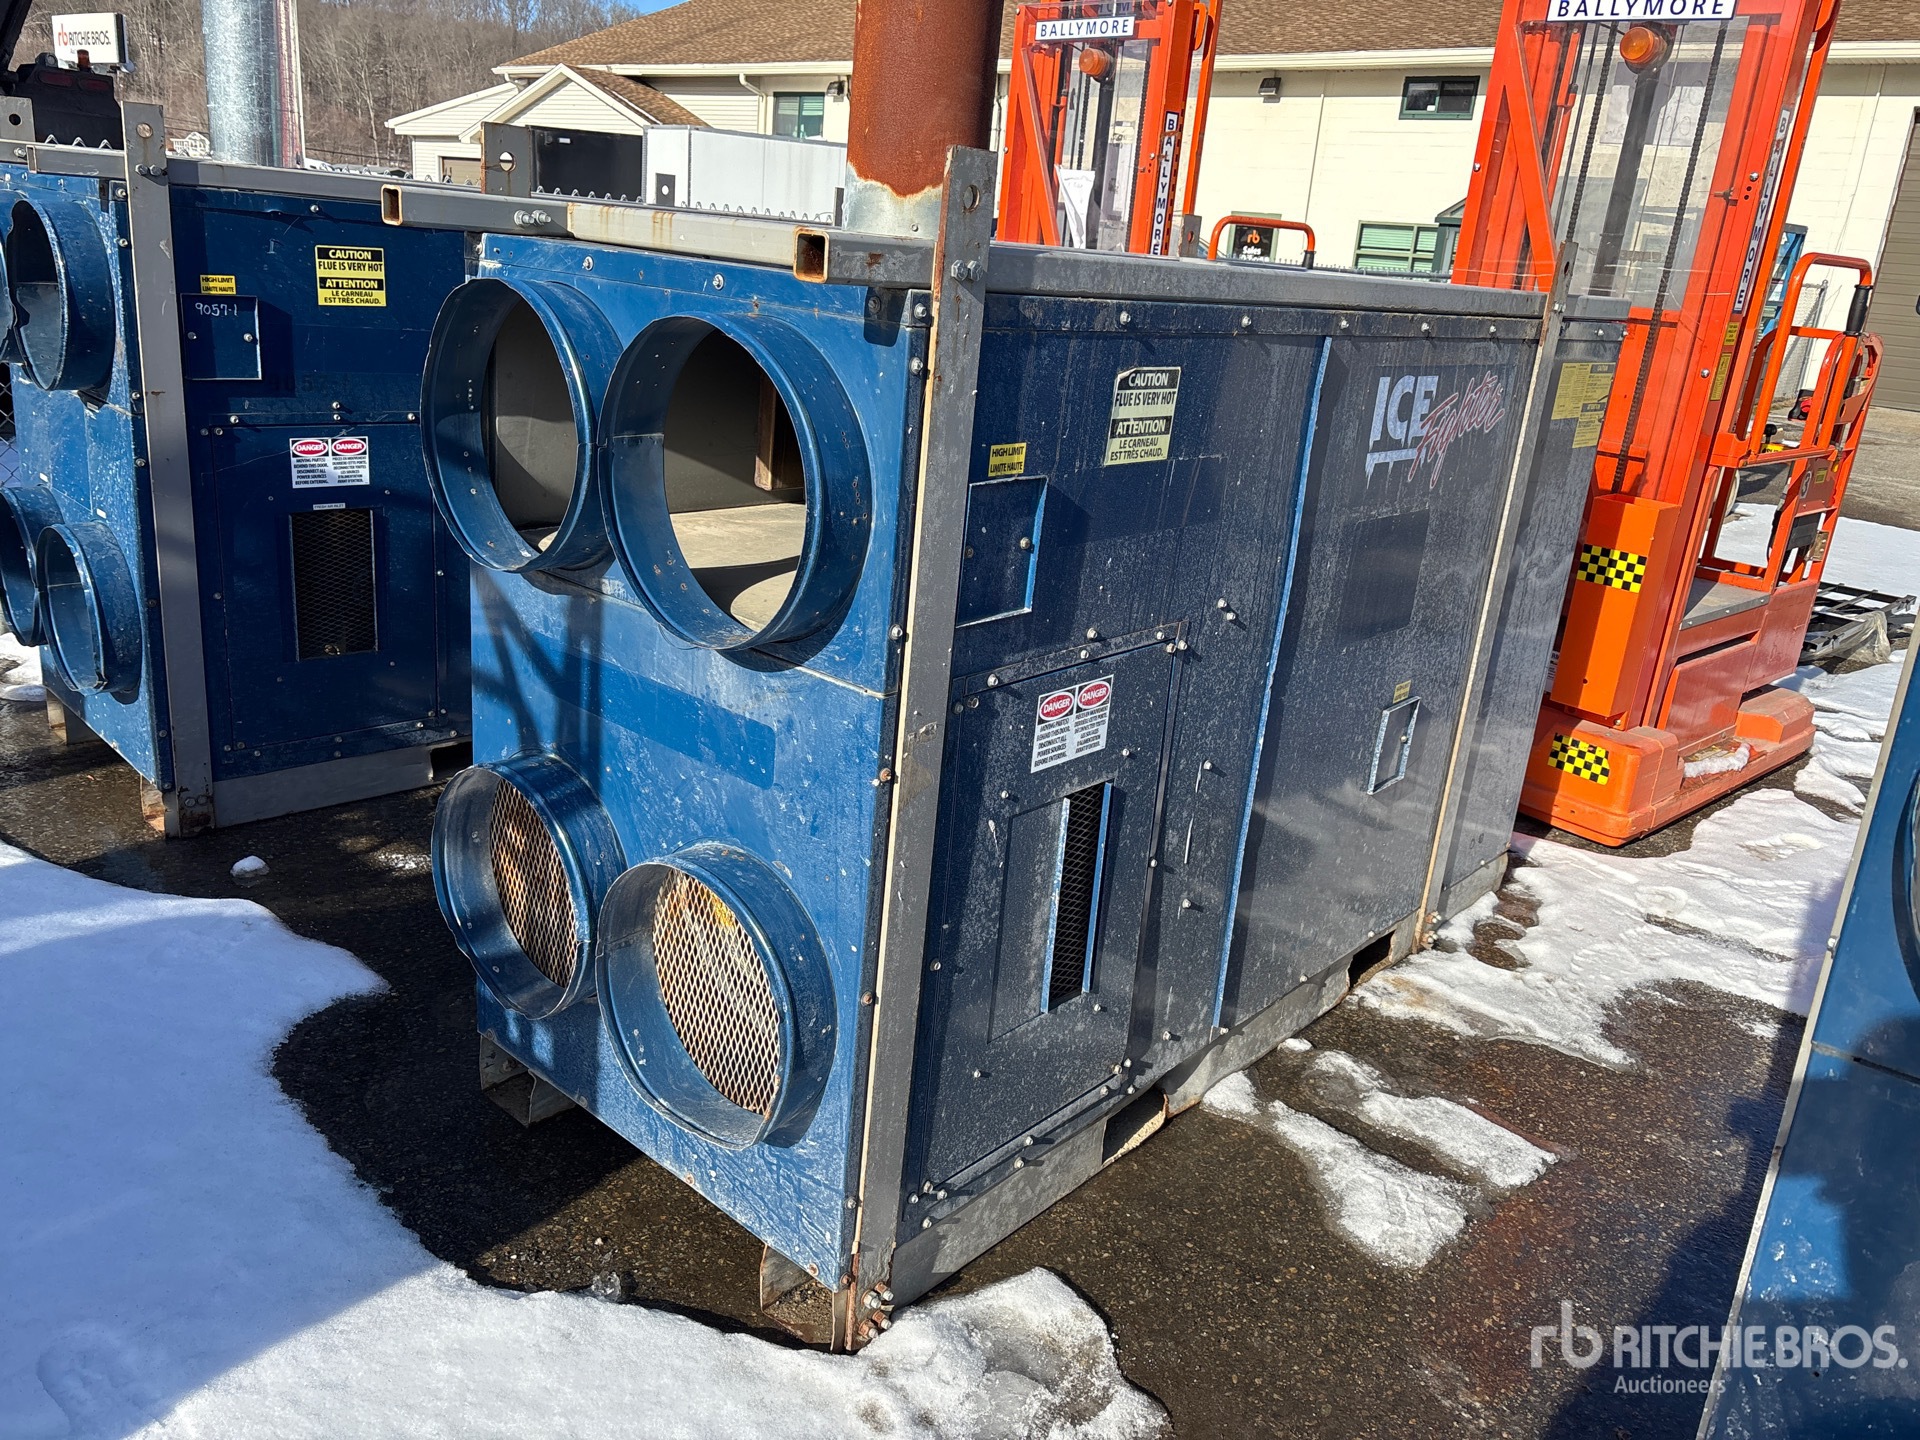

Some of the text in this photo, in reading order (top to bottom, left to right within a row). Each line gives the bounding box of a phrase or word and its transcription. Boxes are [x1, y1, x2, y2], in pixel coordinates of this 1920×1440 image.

[1557, 0, 1724, 17] BALLYMORE
[1040, 19, 1129, 37] BALLYMORE
[69, 31, 91, 46] RITCHIE
[1151, 118, 1176, 255] BALLYMORE
[1738, 117, 1787, 305] BALLYMORE
[328, 249, 372, 260] CAUTION
[318, 260, 383, 272] FLUE IS VERY HOT
[325, 279, 378, 289] ATTENTION
[337, 296, 355, 304] TRÈS
[340, 290, 374, 298] CARNEAU
[195, 302, 239, 317] 9057-1
[1128, 372, 1169, 387] CAUTION
[1114, 391, 1177, 407] FLUE IS VERY HOT
[1115, 418, 1167, 436] ATTENTION
[1369, 374, 1439, 450] ICE
[1408, 370, 1505, 489] Fighter
[296, 444, 324, 452] DANGER
[1119, 437, 1159, 449] LE CARNEAU
[992, 446, 1024, 457] HIGH LIMIT
[1110, 447, 1164, 461] EST TRÈS CHAUD.
[1081, 687, 1107, 702] DANGER
[1043, 698, 1071, 714] DANGER
